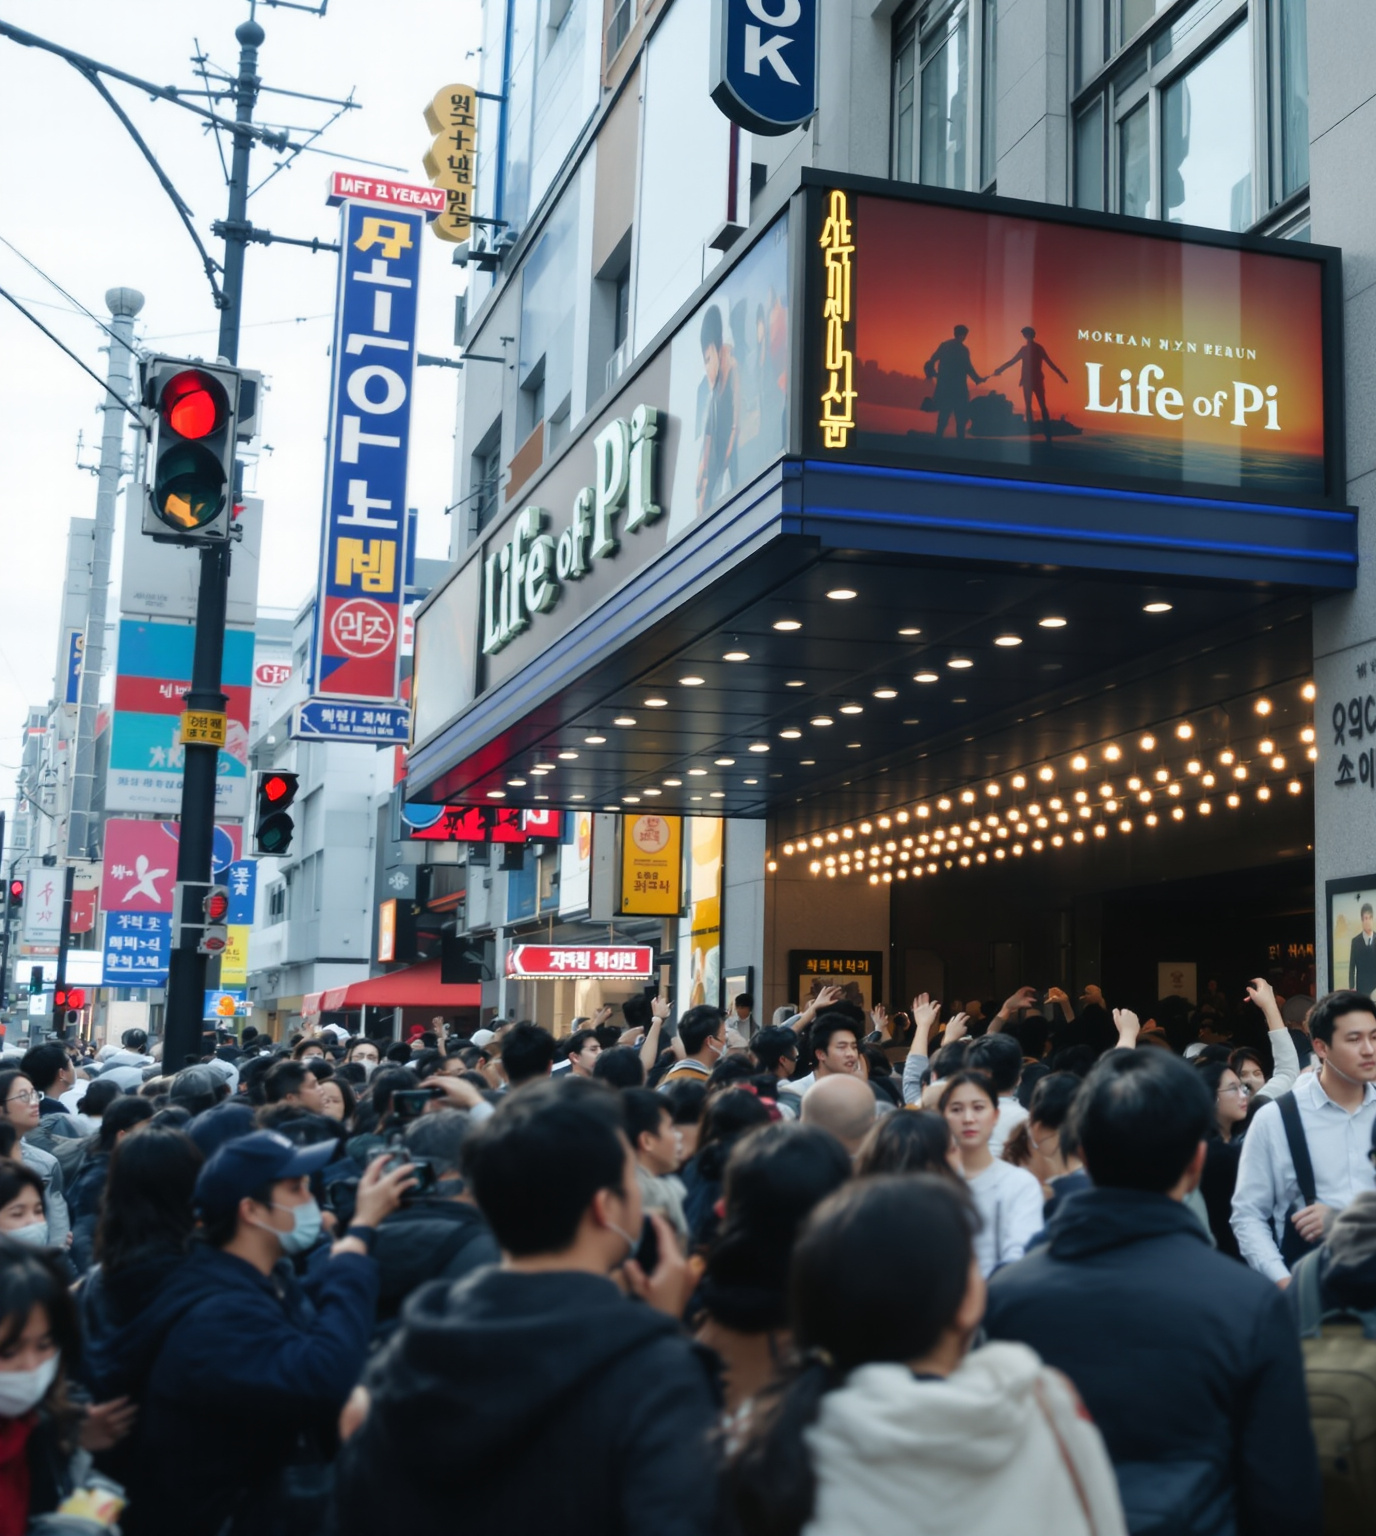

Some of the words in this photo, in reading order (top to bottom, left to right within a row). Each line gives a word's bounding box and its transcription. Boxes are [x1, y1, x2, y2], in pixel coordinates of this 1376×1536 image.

[1085, 362, 1184, 420] Life
[1193, 391, 1228, 418] of
[1230, 381, 1281, 431] Pi
[483, 506, 559, 655] Life
[556, 487, 597, 581] of
[591, 403, 662, 559] Pi
